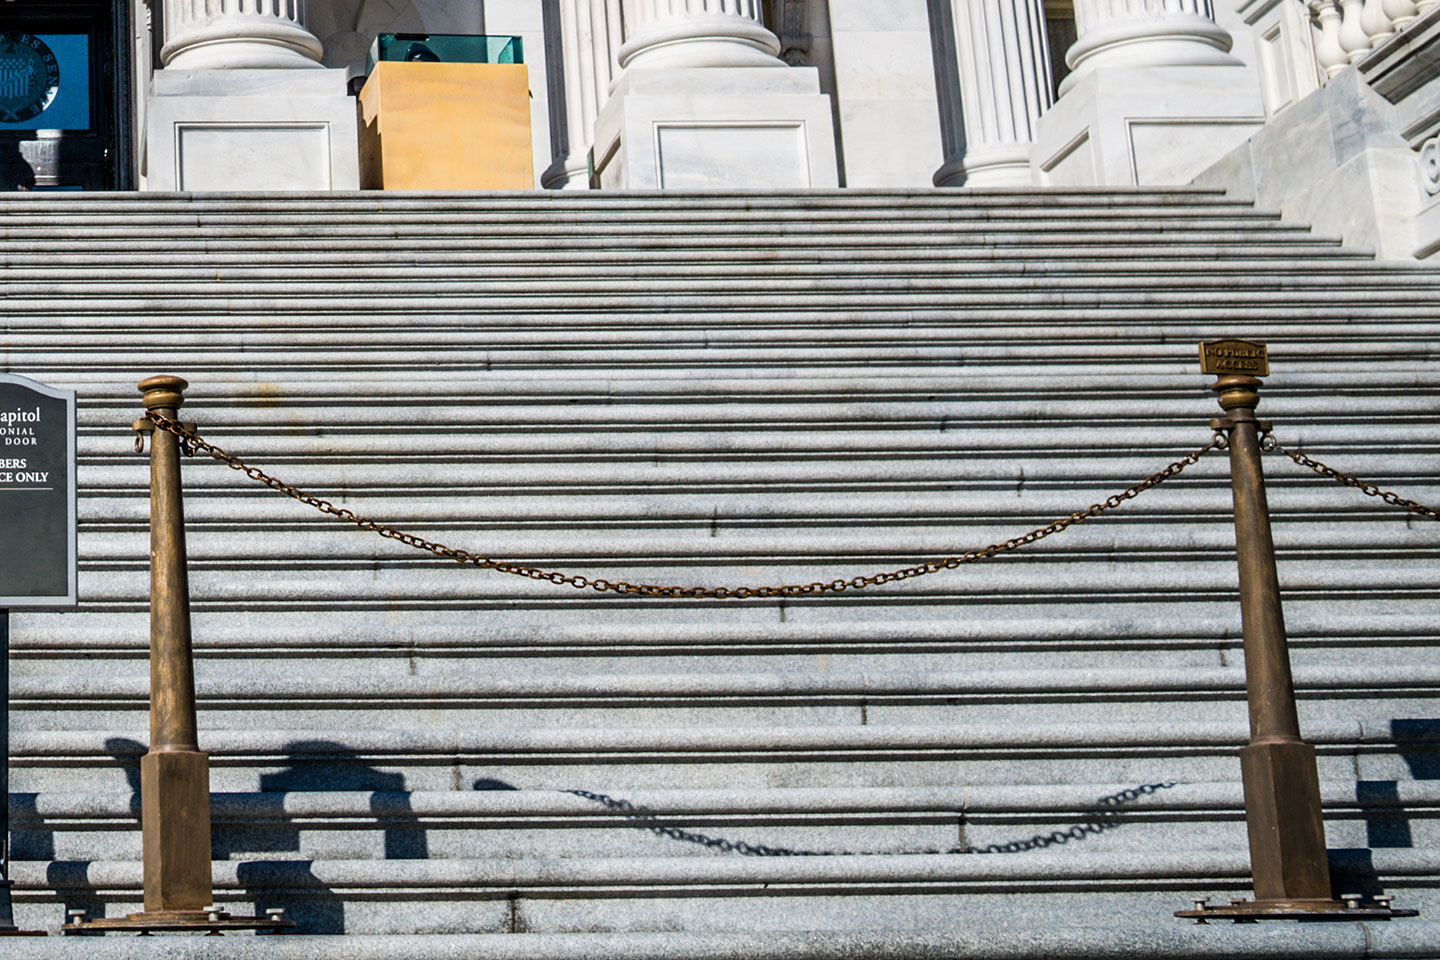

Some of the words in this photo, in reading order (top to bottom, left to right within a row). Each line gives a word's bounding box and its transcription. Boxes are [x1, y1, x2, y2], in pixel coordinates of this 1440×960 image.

[1206, 348, 1223, 358] NO
[1216, 359, 1259, 370] ACCESS
[5, 437, 37, 445] DOOR
[16, 472, 48, 482] ONLY
